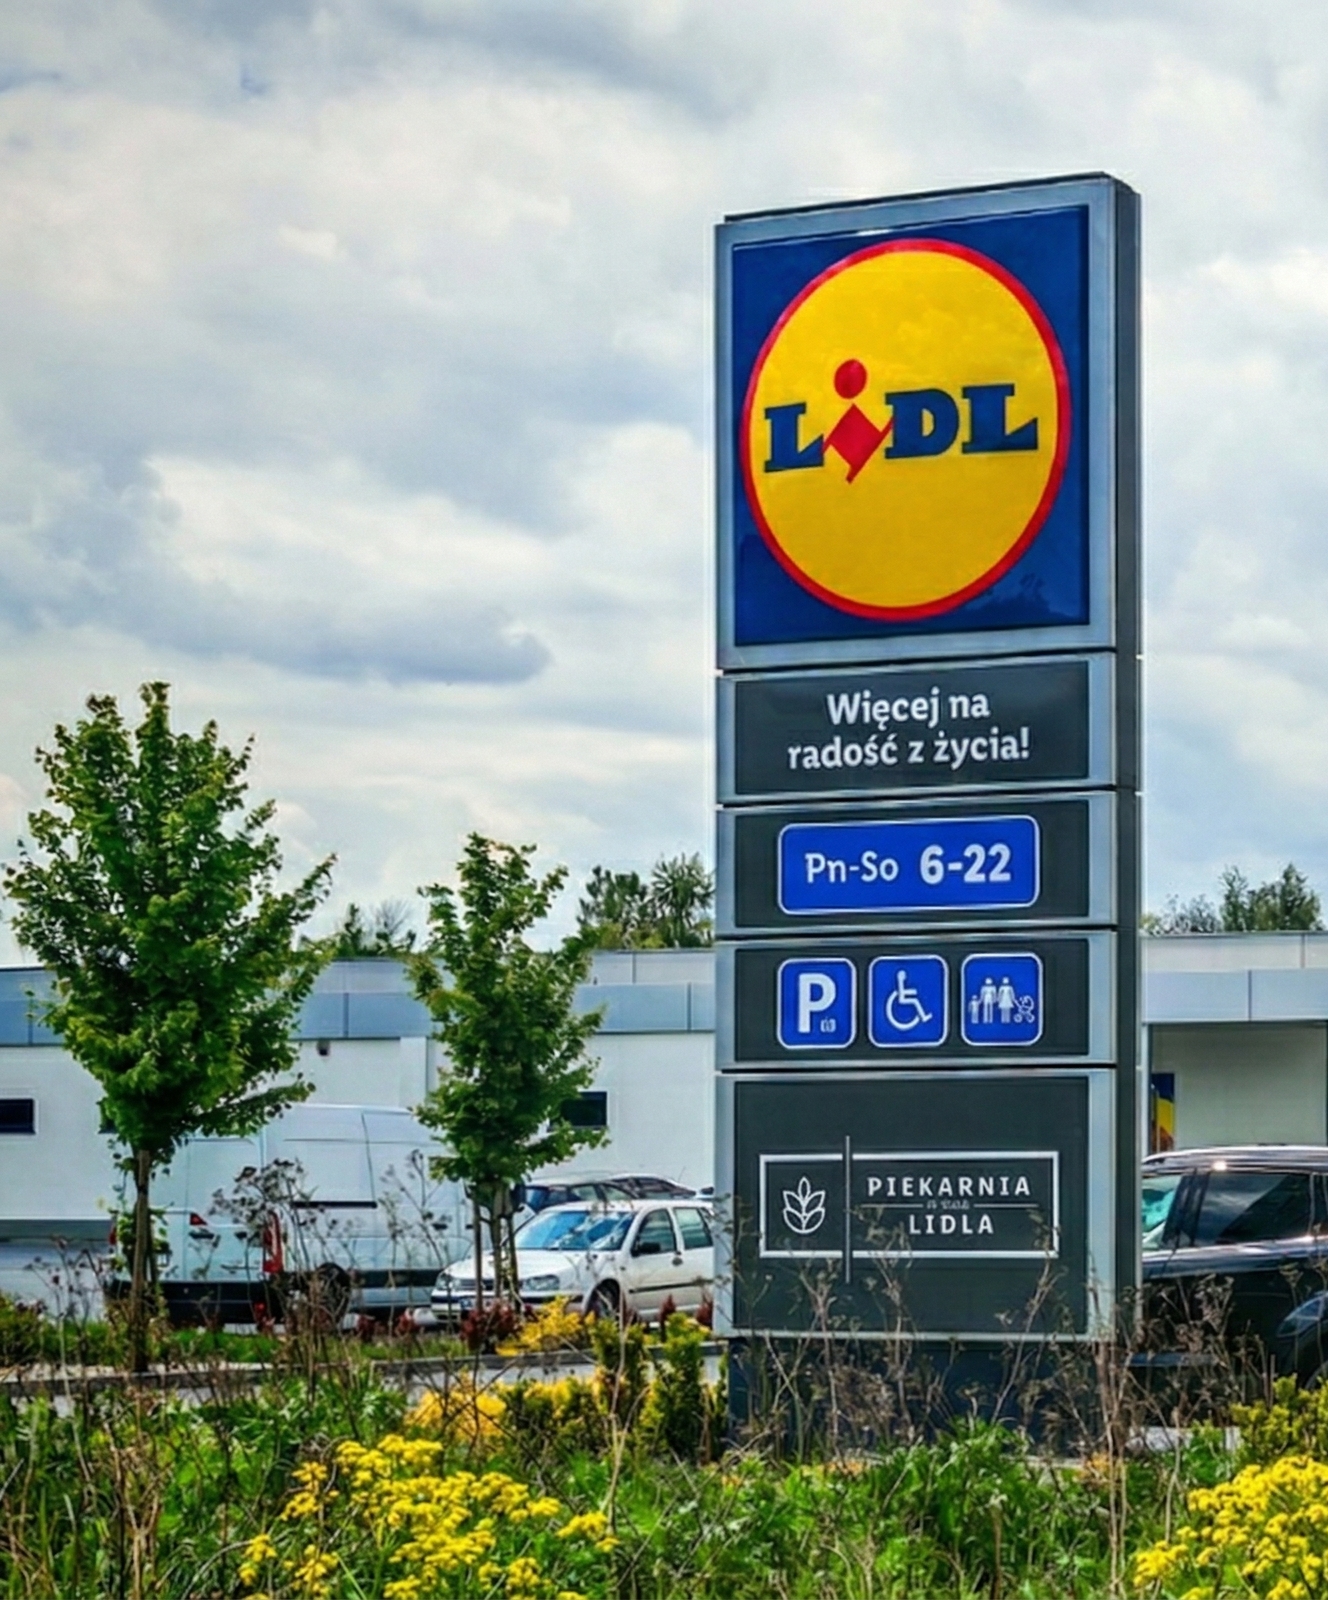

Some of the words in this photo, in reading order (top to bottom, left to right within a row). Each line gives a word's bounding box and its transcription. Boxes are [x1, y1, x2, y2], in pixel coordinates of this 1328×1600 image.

[827, 686, 940, 730] Więcej
[948, 693, 990, 719] na
[788, 734, 898, 770] radość
[907, 739, 925, 763] z
[933, 726, 1030, 770] życia!
[805, 850, 899, 884] Pn-So
[919, 842, 1012, 885] 6-22
[798, 972, 837, 1033] P
[867, 1176, 1031, 1197] PIEKARNIA
[909, 1213, 994, 1236] LIDLA
